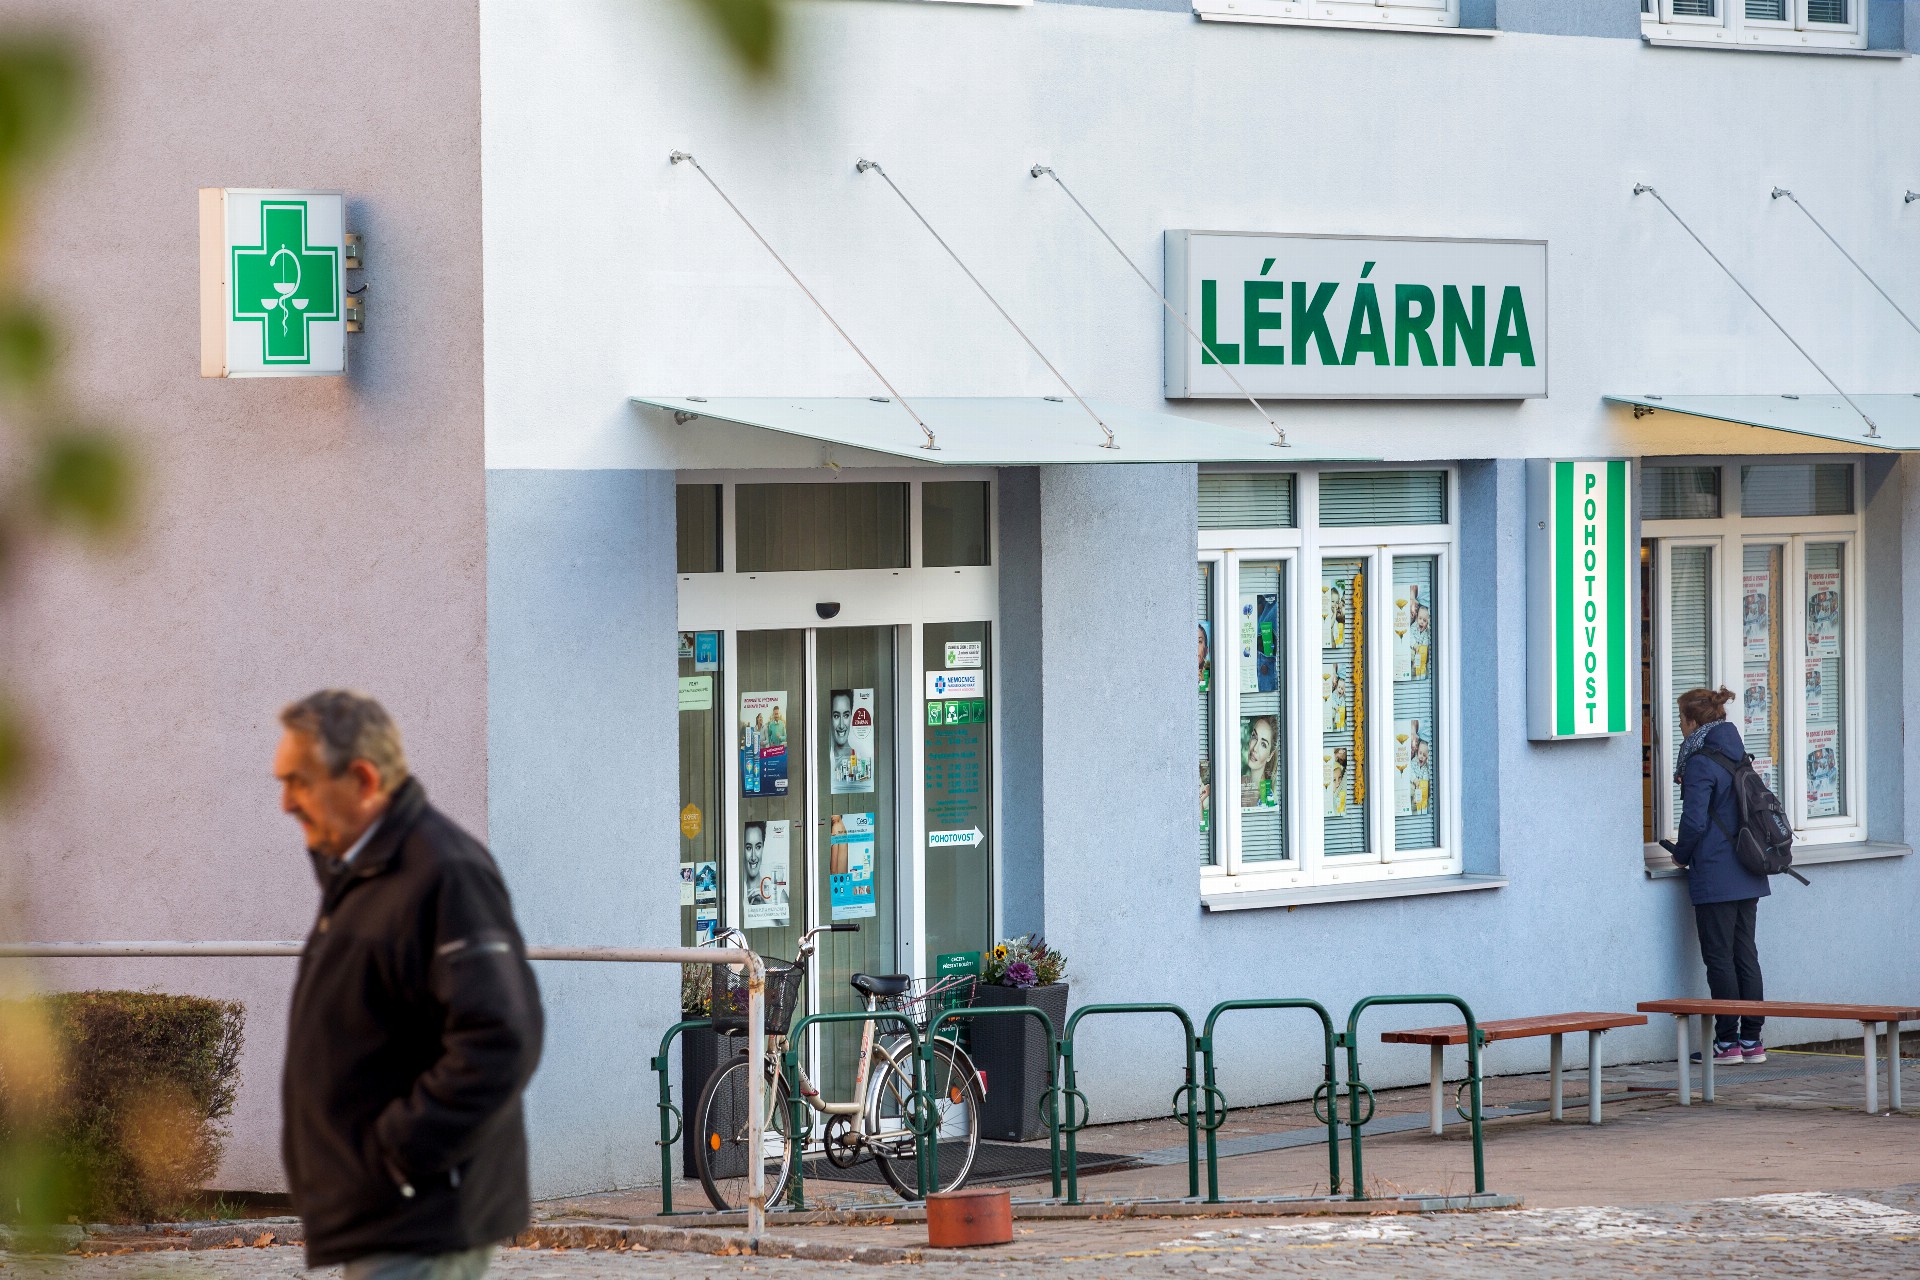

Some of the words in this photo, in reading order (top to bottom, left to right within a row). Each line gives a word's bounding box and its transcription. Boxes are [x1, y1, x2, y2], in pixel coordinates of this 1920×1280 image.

[1201, 258, 1536, 367] LÉKÁRNA
[1584, 473, 1597, 724] POHOTOVOST
[930, 832, 975, 843] POHOTOVOST
